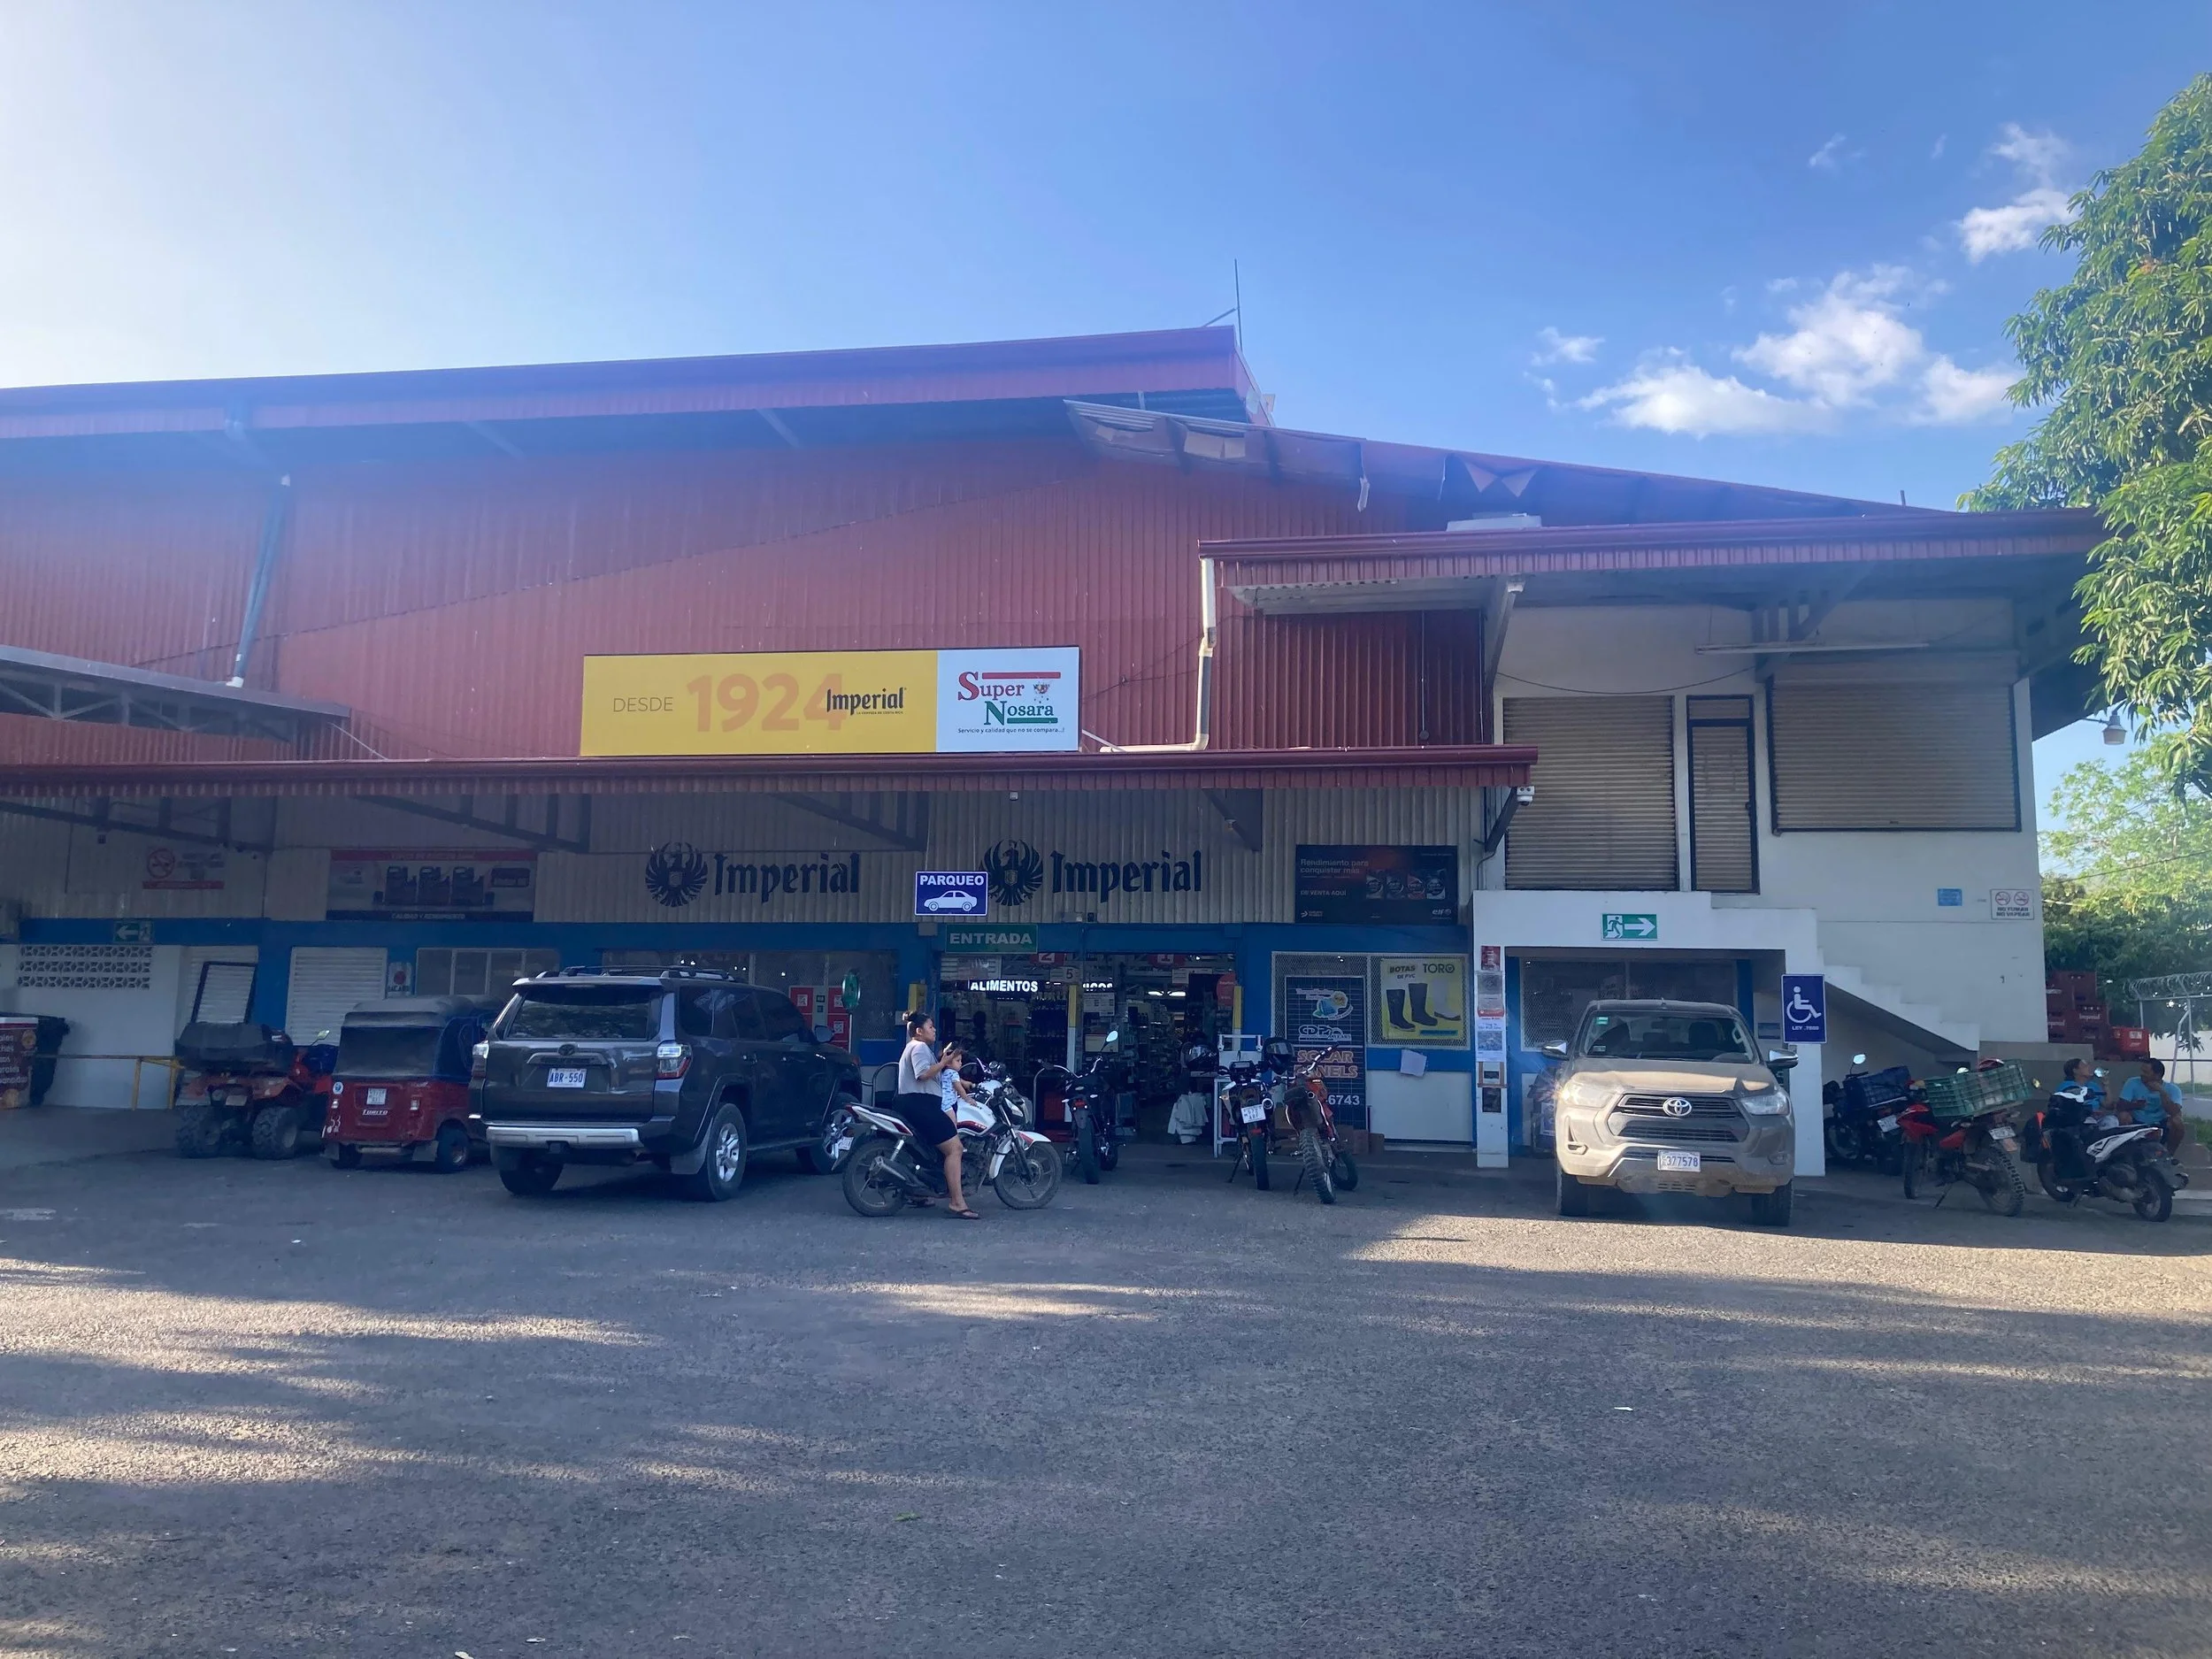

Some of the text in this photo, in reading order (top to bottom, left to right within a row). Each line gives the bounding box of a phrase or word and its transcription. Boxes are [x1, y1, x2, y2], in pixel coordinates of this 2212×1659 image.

[957, 671, 1025, 701] Super
[612, 696, 674, 713] DESDE
[687, 672, 847, 733] 1924
[826, 687, 904, 716] Imperial
[983, 701, 1054, 726] Nosara
[1351, 860, 1369, 869] para
[714, 852, 860, 904] Imperial
[919, 874, 985, 887] PARQUEO
[1049, 849, 1202, 903] Imperial
[949, 933, 1033, 945] ENTRADA
[1423, 964, 1455, 973] TORO
[970, 979, 1038, 992] ALIMENTOS
[549, 1072, 584, 1083] ABR-550
[1294, 1064, 1359, 1079] PNELS
[1666, 1156, 1699, 1167] 377578
